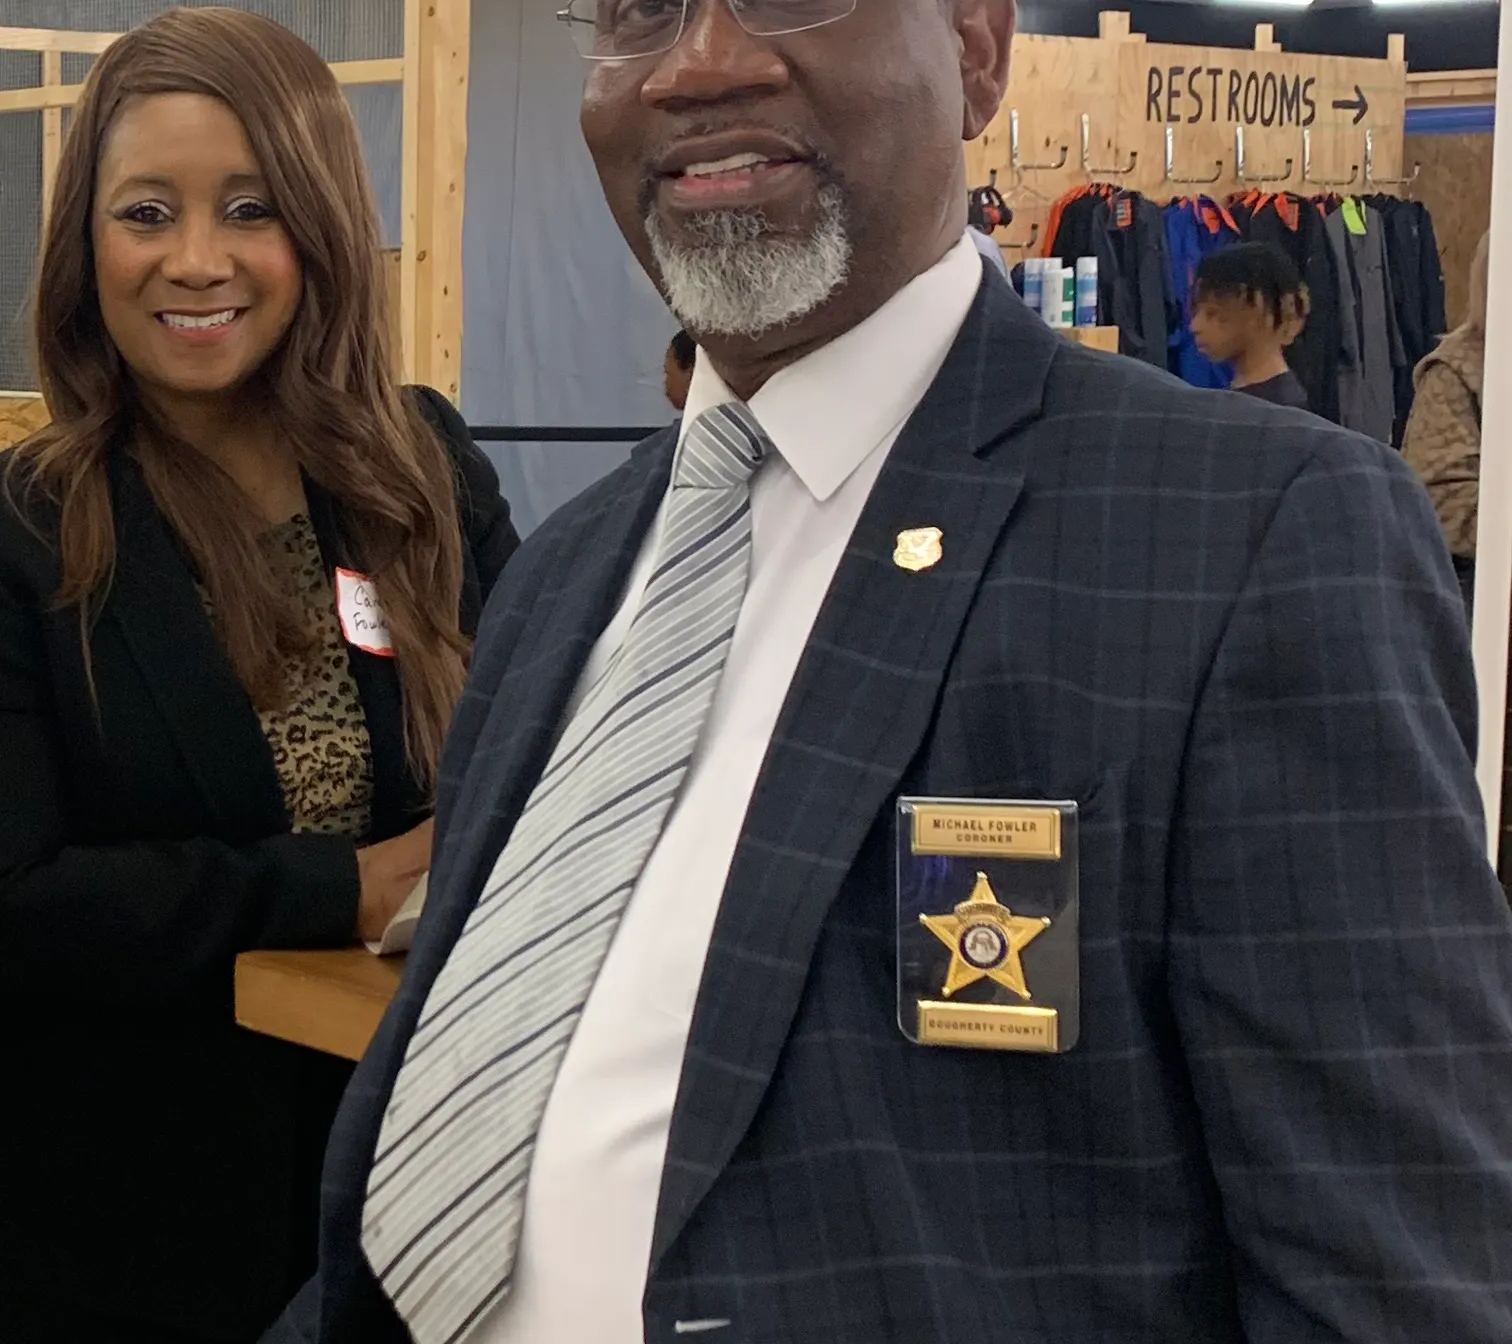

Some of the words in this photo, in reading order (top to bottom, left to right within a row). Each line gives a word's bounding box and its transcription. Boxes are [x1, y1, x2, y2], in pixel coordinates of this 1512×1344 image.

[1145, 65, 1317, 128] RESTROOMS
[932, 818, 984, 833] MICHAEL
[989, 820, 1038, 834] FOWLER
[956, 833, 1013, 844] CORONER
[999, 1023, 1044, 1036] COUNTY
